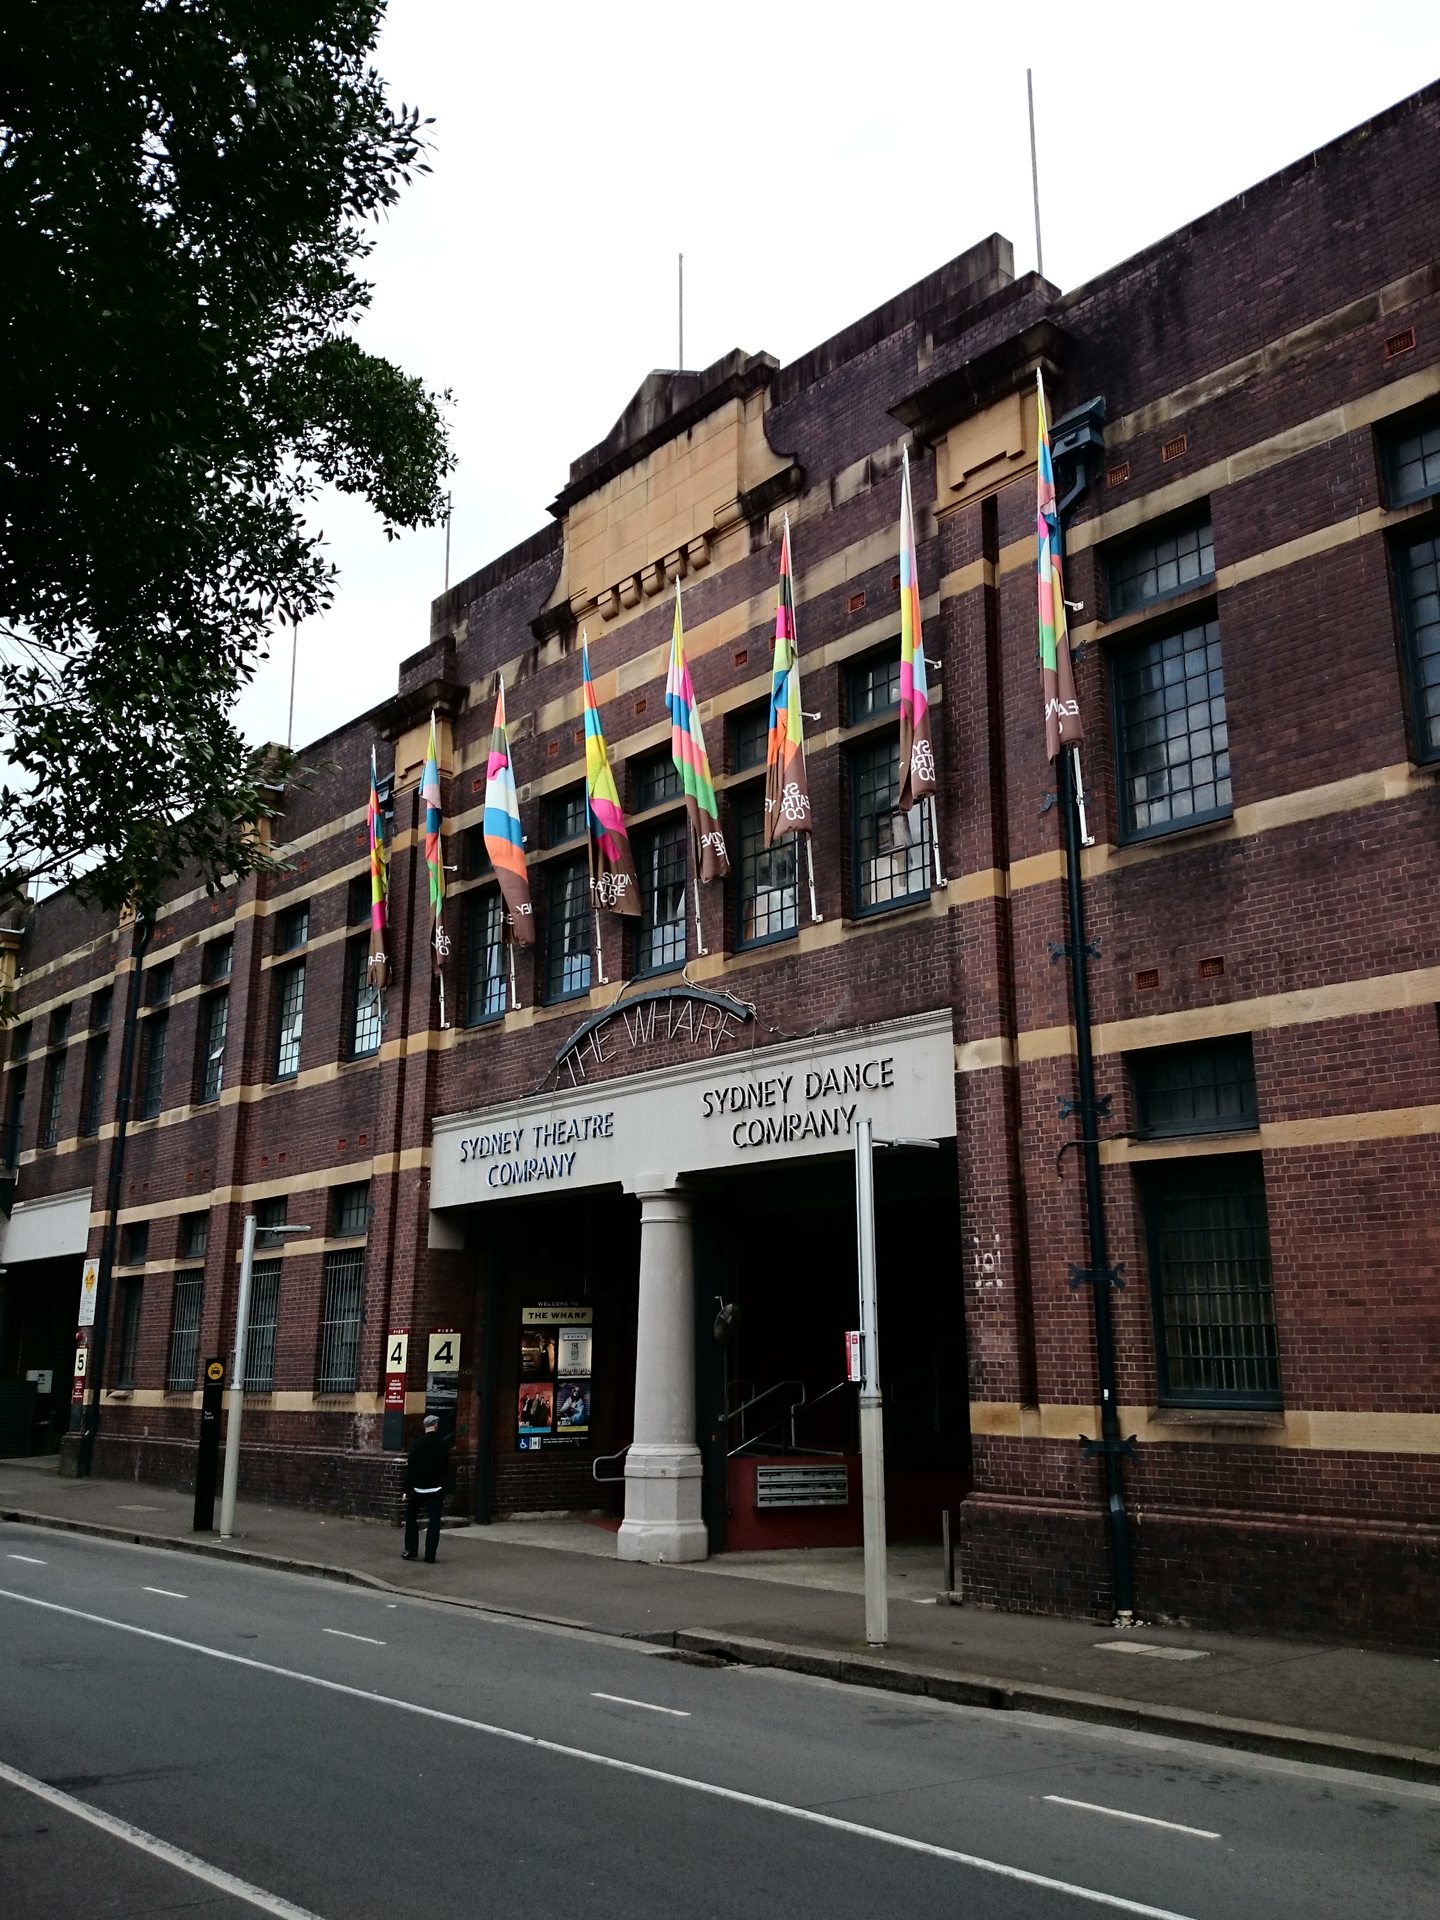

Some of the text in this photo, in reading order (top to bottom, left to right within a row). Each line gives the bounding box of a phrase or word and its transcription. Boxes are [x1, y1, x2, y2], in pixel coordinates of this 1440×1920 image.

[600, 891, 617, 906] CO
[559, 998, 745, 1087] THE WHARF
[701, 1056, 895, 1118] SYDNEY DANCE
[459, 1111, 615, 1164] SYDNEY THEATRE
[731, 1103, 858, 1149] COMPANY
[486, 1151, 577, 1189] COMPANY
[77, 1353, 84, 1371] 5
[390, 1341, 403, 1365] 4
[434, 1340, 454, 1364] 4
